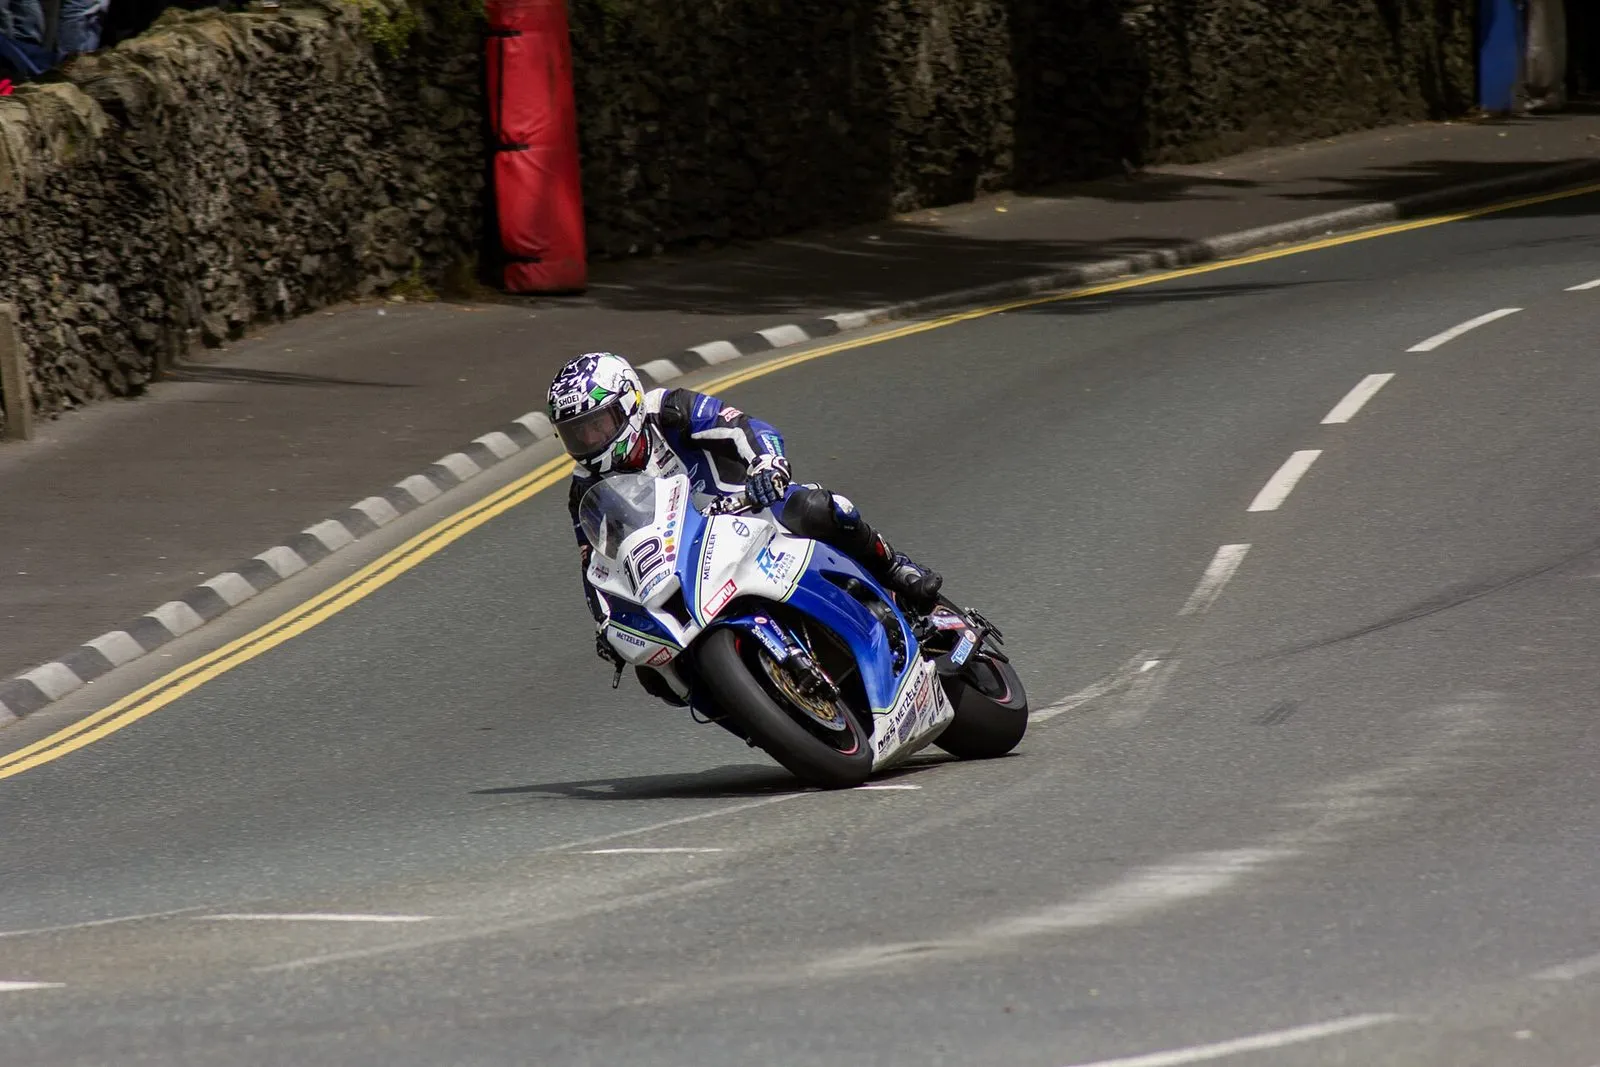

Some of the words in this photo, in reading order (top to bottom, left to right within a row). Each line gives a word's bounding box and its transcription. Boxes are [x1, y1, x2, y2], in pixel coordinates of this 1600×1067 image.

[558, 394, 580, 408] SHOEI
[623, 536, 666, 597] 12
[703, 534, 717, 580] METZELER
[616, 631, 646, 648] METZELER
[895, 676, 922, 724] METZELER
